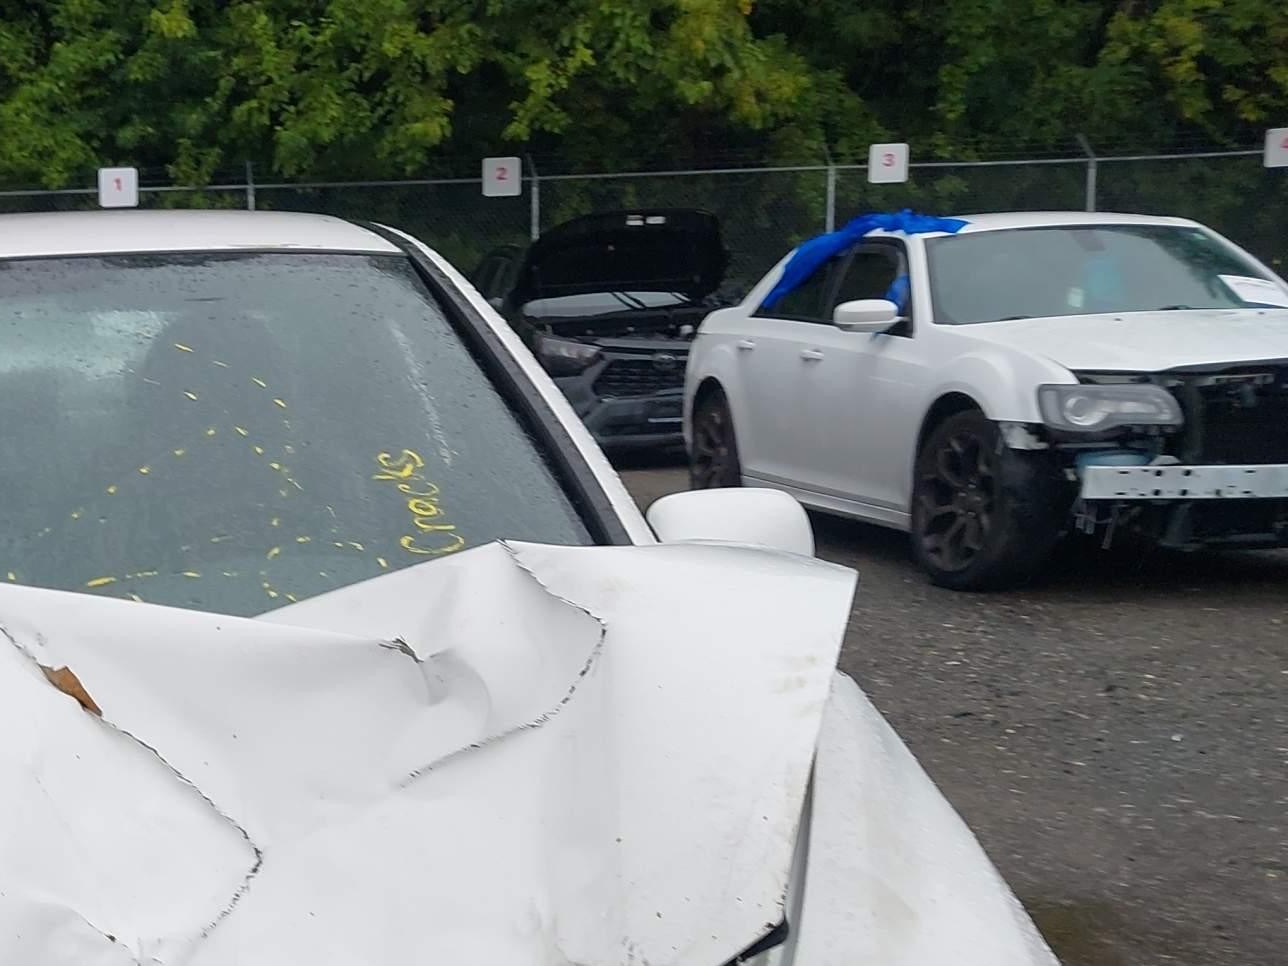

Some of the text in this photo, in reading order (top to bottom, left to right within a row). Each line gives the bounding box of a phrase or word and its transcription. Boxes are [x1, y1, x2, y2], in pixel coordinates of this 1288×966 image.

[882, 152, 896, 167] 3
[495, 166, 508, 181] 2
[372, 448, 465, 554] Cracks
